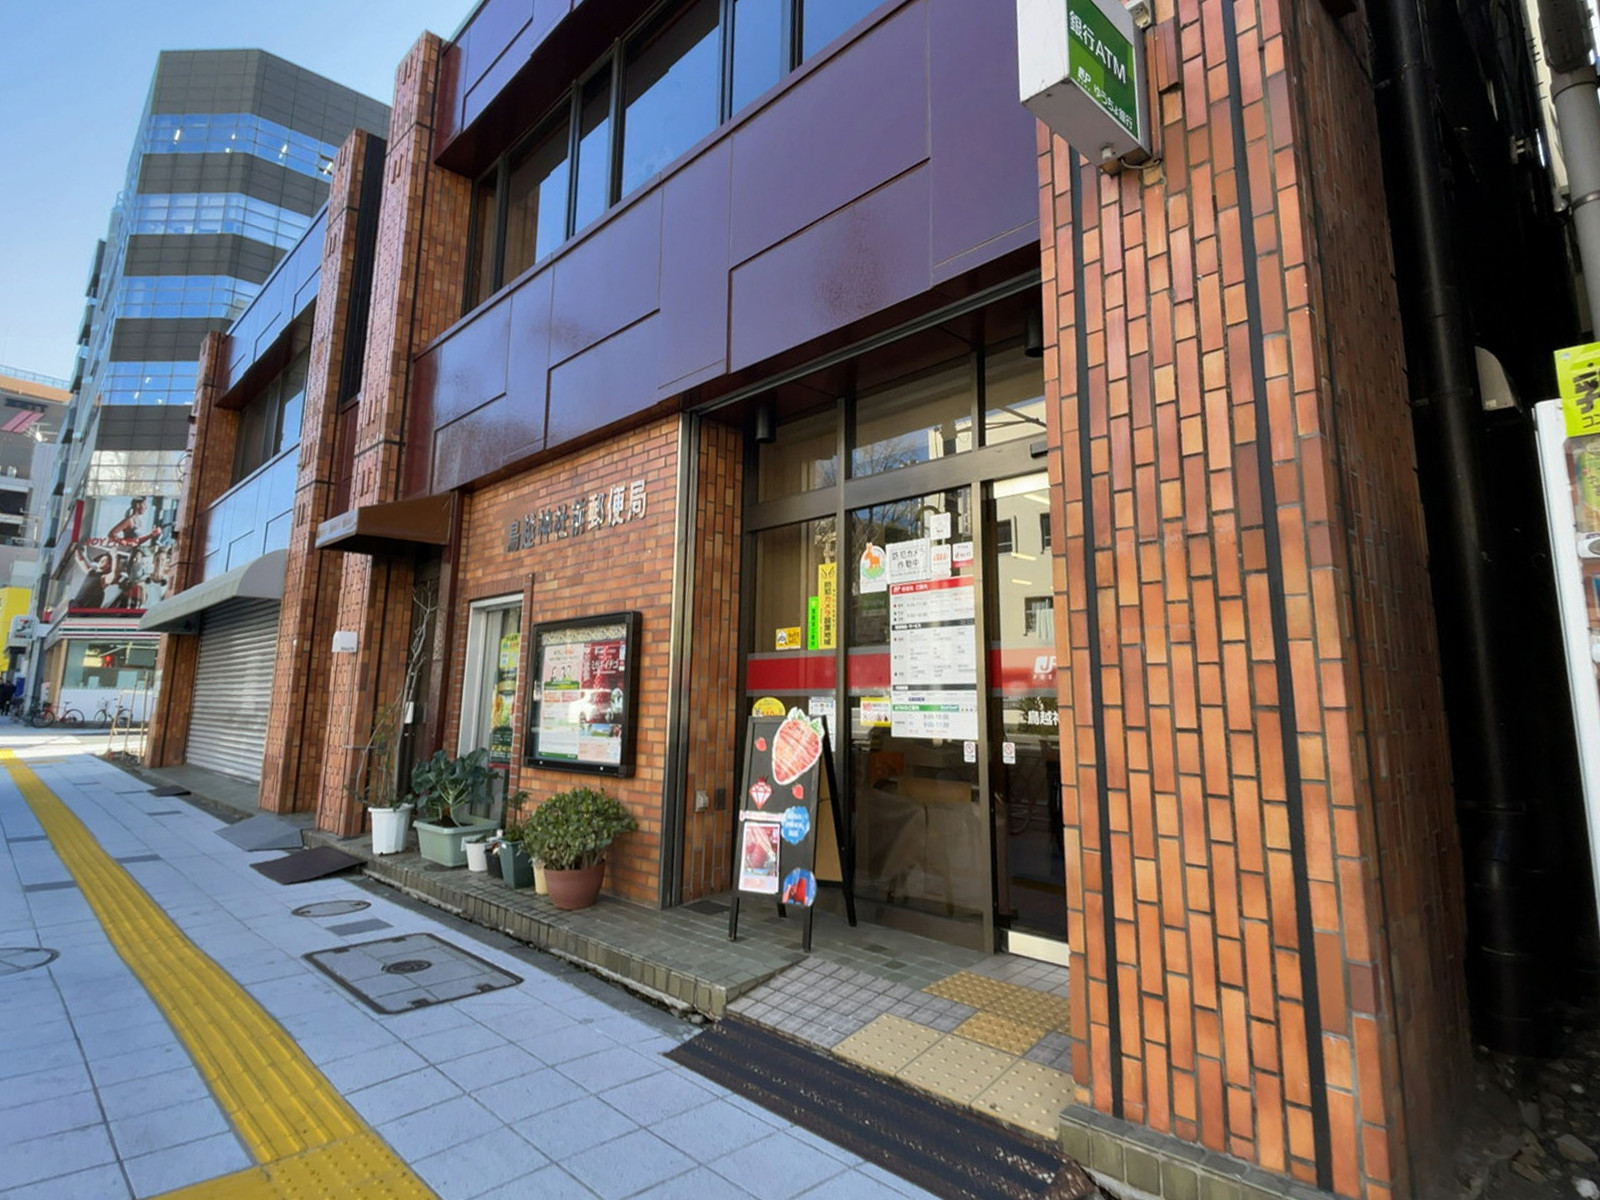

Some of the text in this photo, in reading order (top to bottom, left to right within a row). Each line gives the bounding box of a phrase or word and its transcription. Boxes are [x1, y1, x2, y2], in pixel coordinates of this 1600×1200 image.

[1069, 10, 1127, 84] 銀行ATM
[1093, 83, 1133, 131] ゆうちょ銀行
[507, 479, 647, 552] 鳥越神社前郵便局
